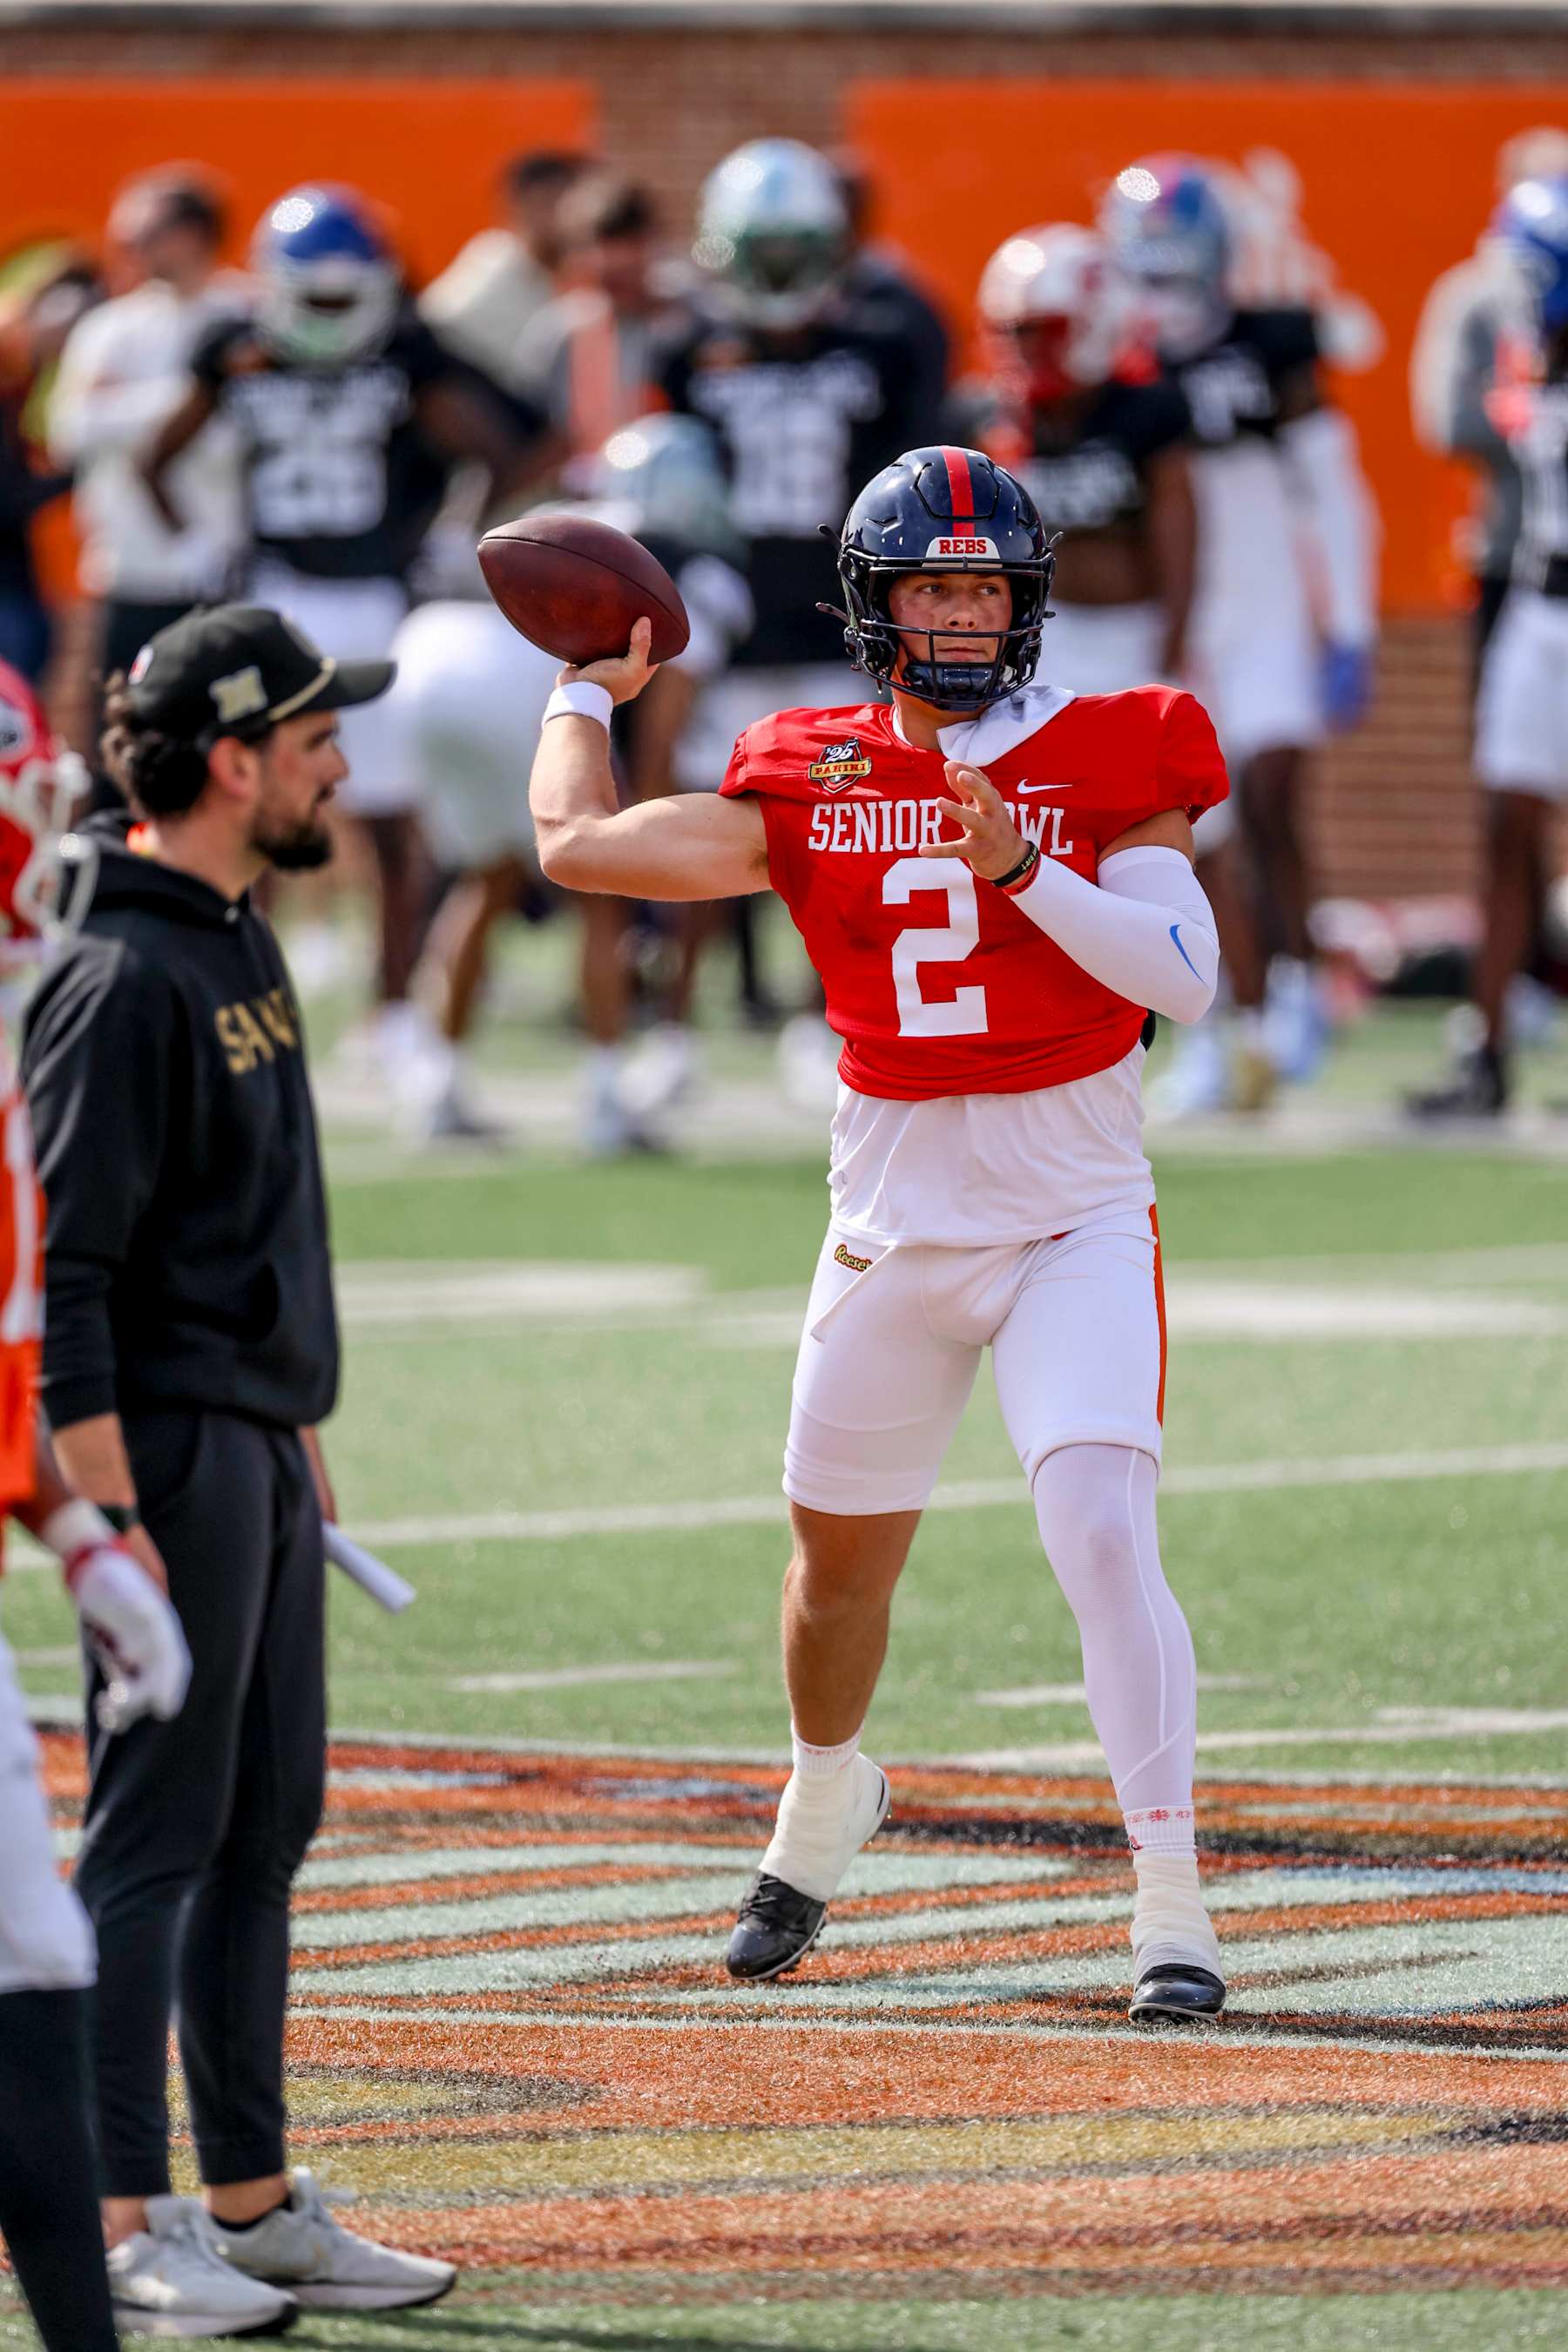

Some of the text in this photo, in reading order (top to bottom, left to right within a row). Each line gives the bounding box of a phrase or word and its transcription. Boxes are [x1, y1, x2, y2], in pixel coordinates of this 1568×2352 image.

[939, 539, 987, 554] REBS
[815, 763, 865, 775] PANINI
[808, 799, 1073, 855] SENIOR WL
[882, 856, 989, 1037] 2
